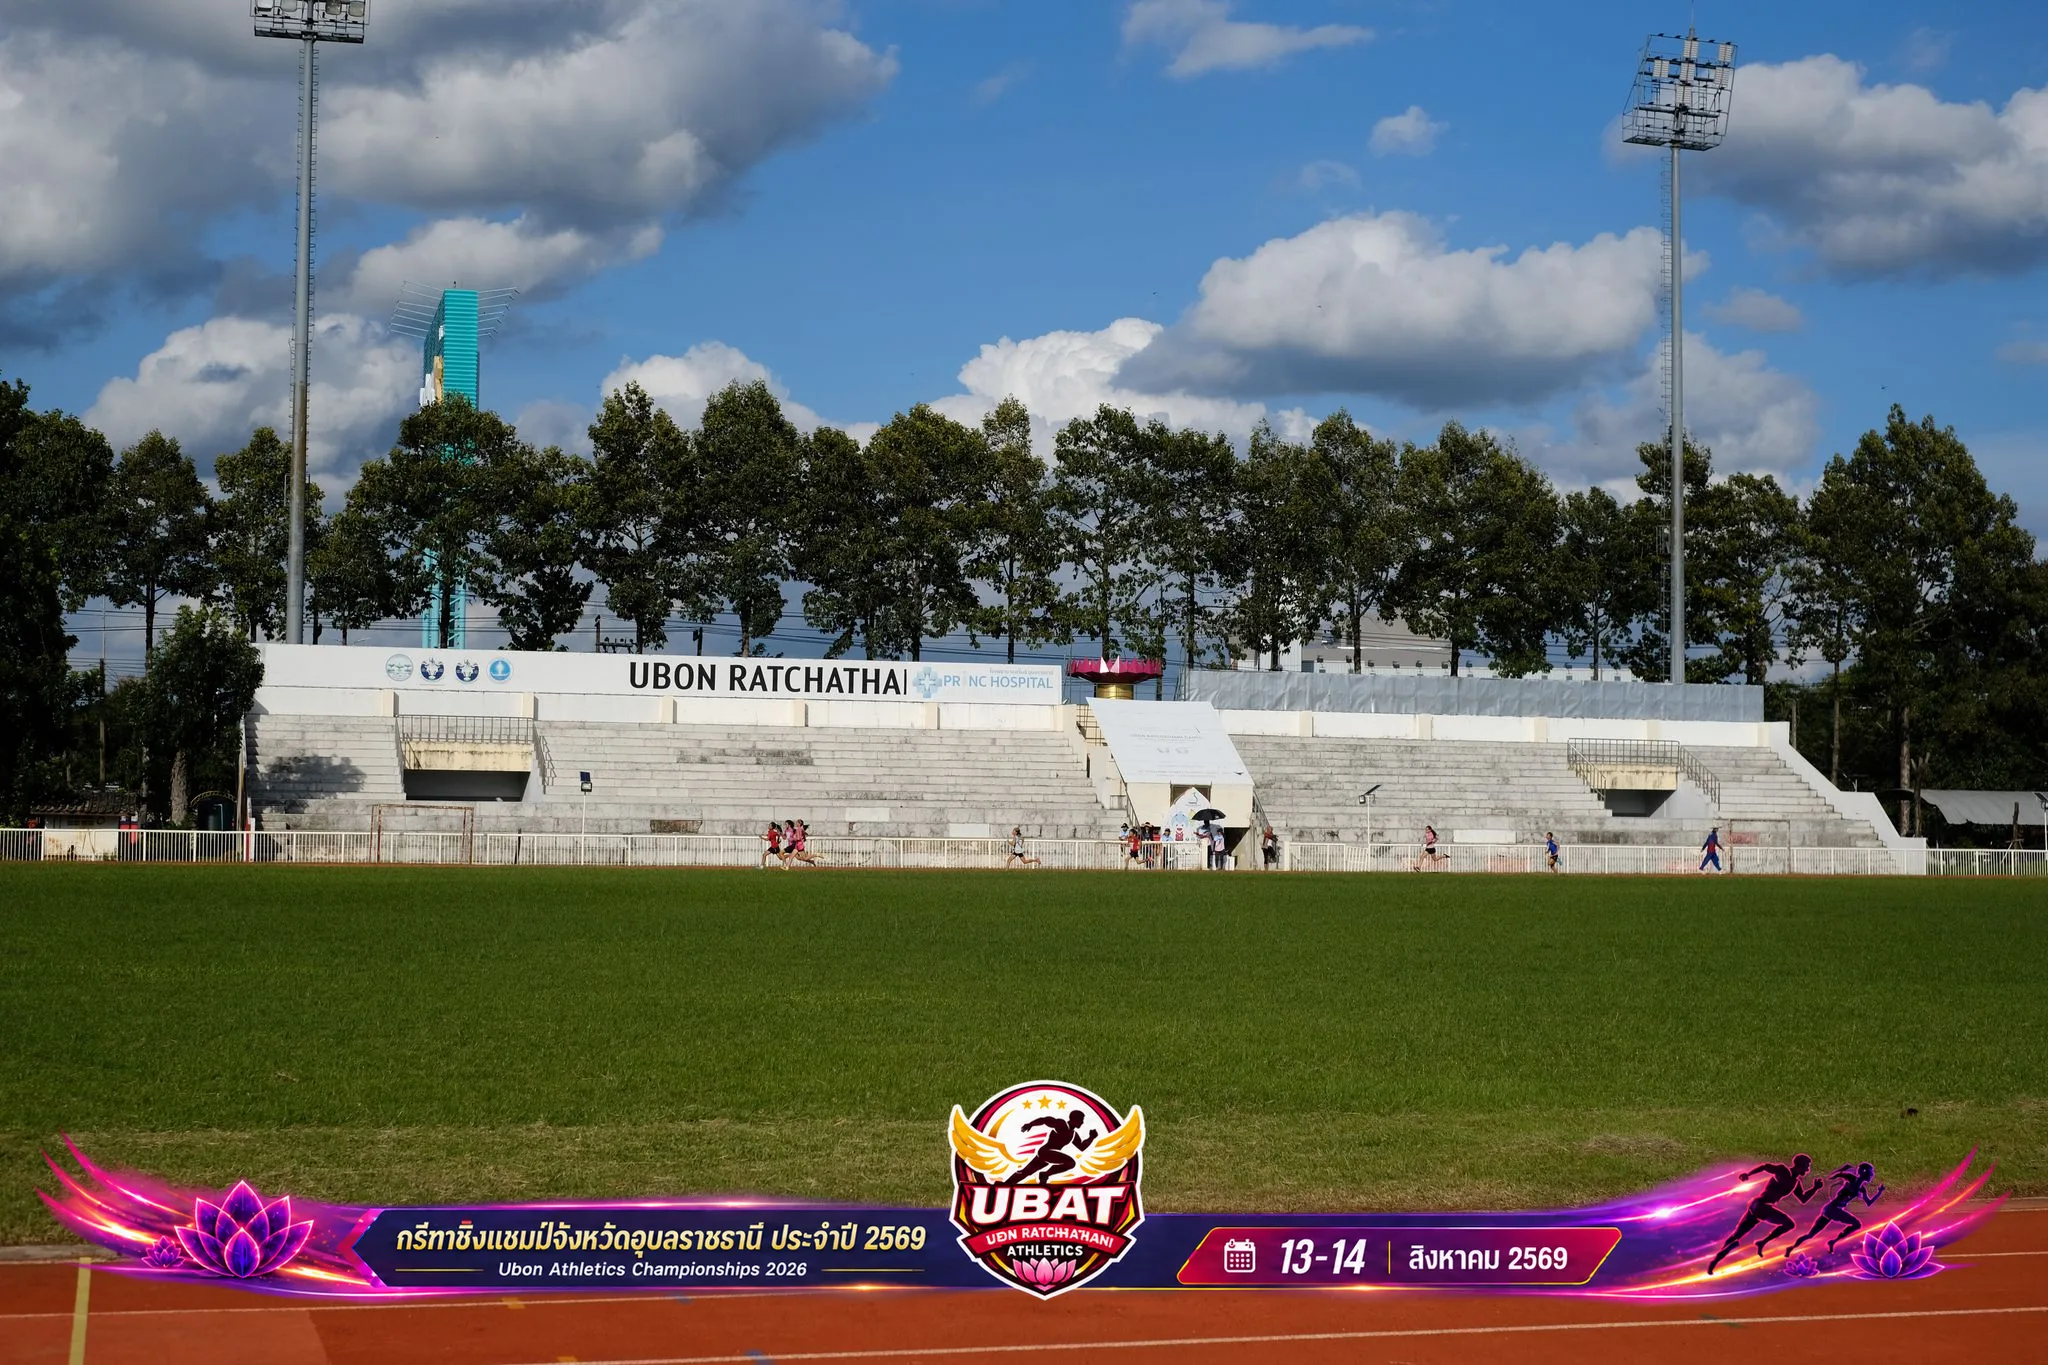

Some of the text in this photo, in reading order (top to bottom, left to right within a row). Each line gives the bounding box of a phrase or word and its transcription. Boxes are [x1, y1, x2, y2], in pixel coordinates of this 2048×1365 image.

[629, 661, 907, 696] UBON RATCHATHA
[990, 675, 1054, 690] HOSPITAL
